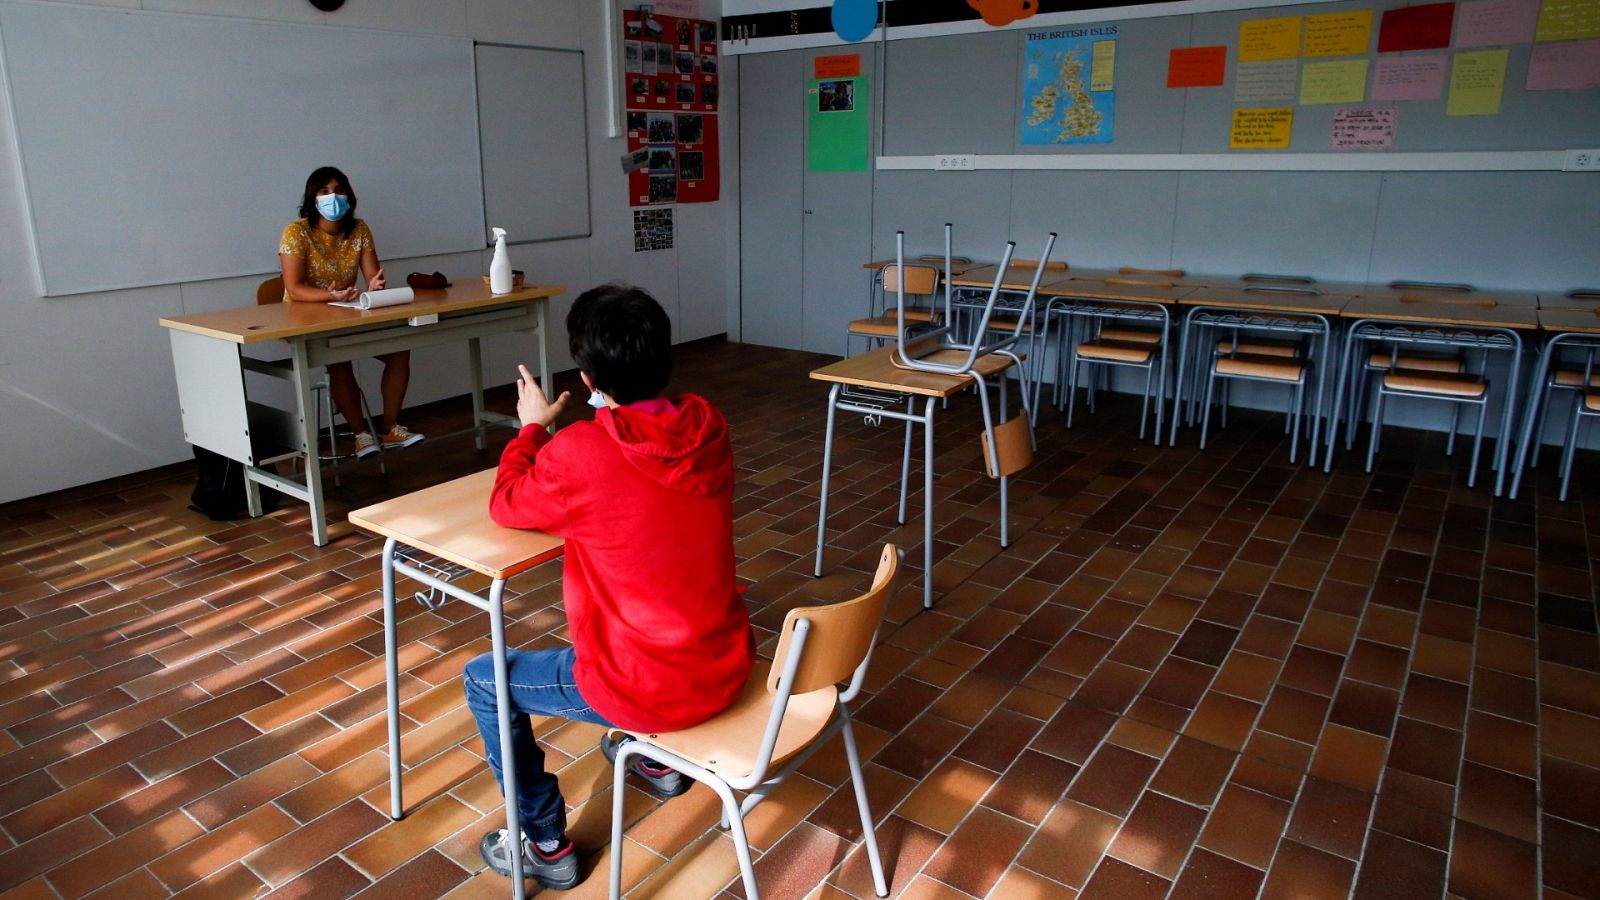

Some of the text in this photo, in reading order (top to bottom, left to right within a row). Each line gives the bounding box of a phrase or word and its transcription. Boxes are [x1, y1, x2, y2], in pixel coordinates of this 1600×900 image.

[1027, 25, 1118, 40] THE BRITISH ISLES
